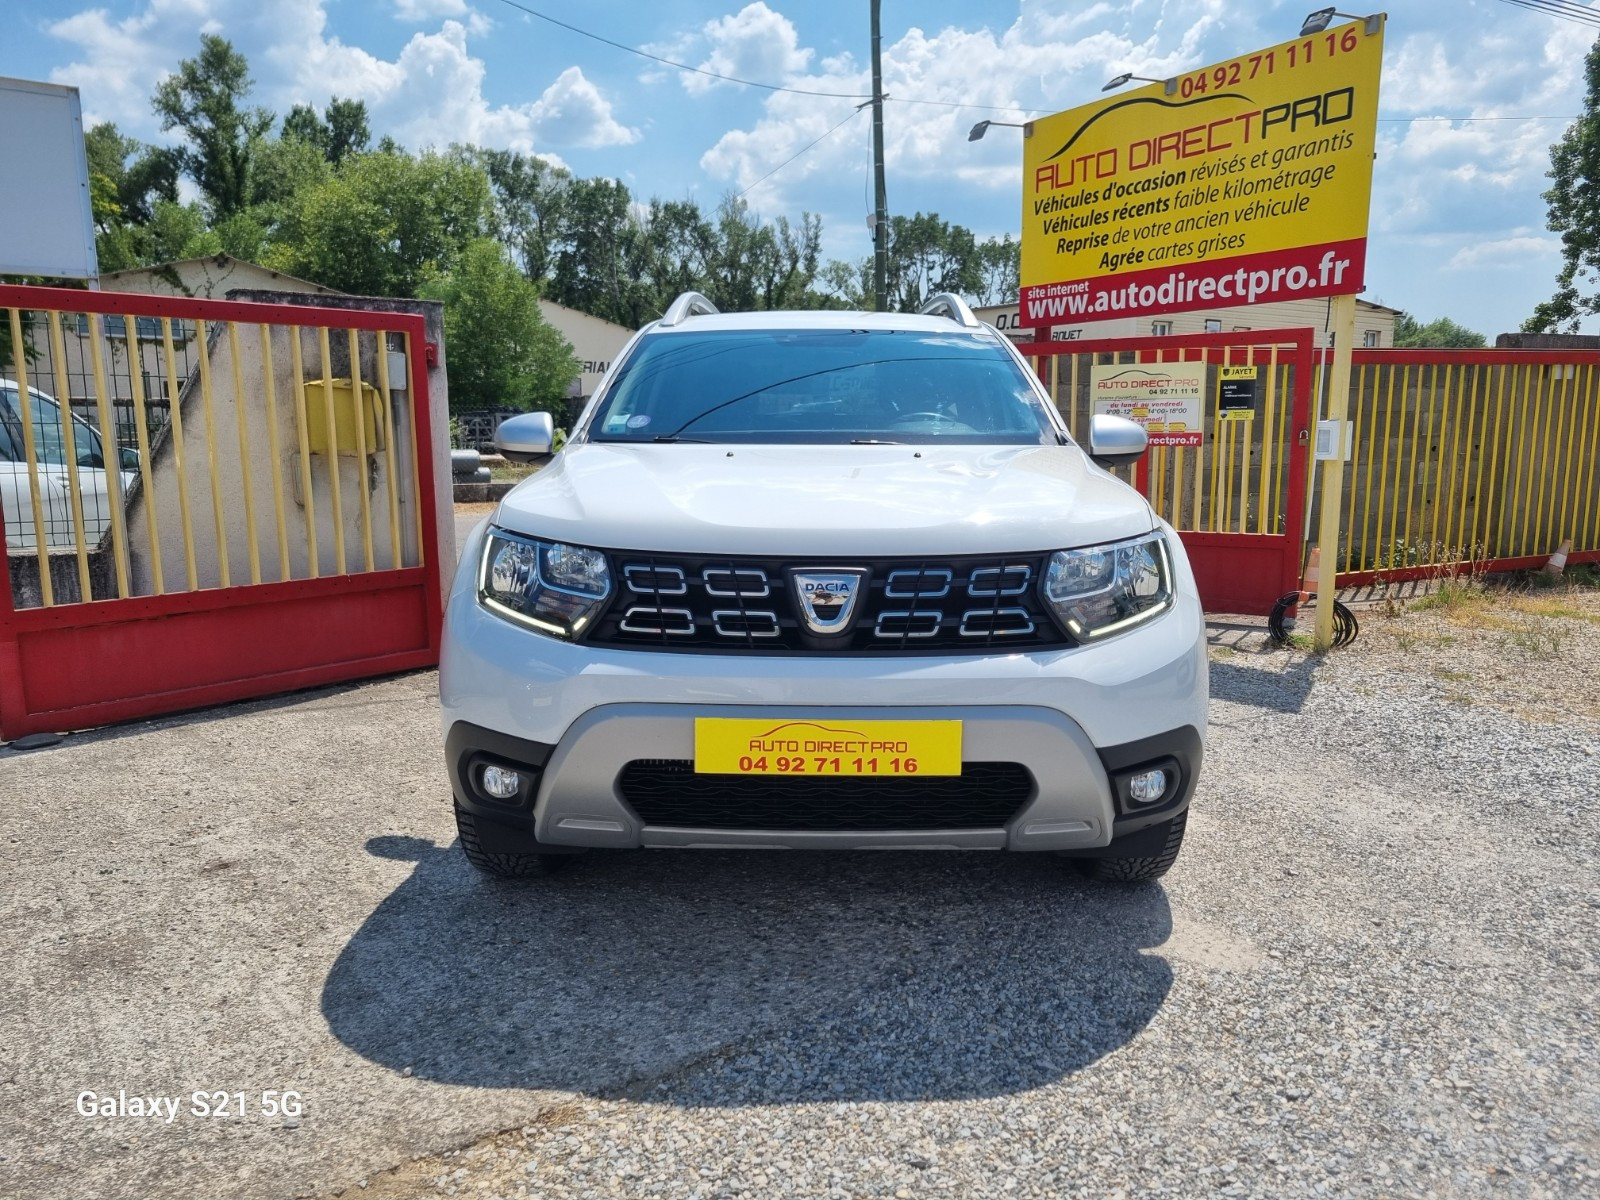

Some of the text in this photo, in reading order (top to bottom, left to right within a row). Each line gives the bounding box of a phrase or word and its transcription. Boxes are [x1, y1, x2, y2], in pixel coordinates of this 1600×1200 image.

[1181, 27, 1358, 99] 04 92 71 11 16
[1034, 129, 1354, 216] Véhicules d'occasion révisés et garantis
[1035, 148, 1118, 194] AUTO
[1043, 164, 1336, 235] Véhicules récents faible kilométrage
[1056, 193, 1310, 256] Reprise de votre ancien véhicule
[1099, 232, 1246, 271] Agrée cartes grises
[1027, 250, 1351, 320] www.autodirectpro.fr
[1028, 280, 1090, 300] site internet
[1097, 378, 1199, 390] AUTO DIRECT PRO
[805, 583, 849, 592] DACIA
[739, 756, 918, 773] 04 92 71 11 16
[749, 740, 798, 752] AUTO
